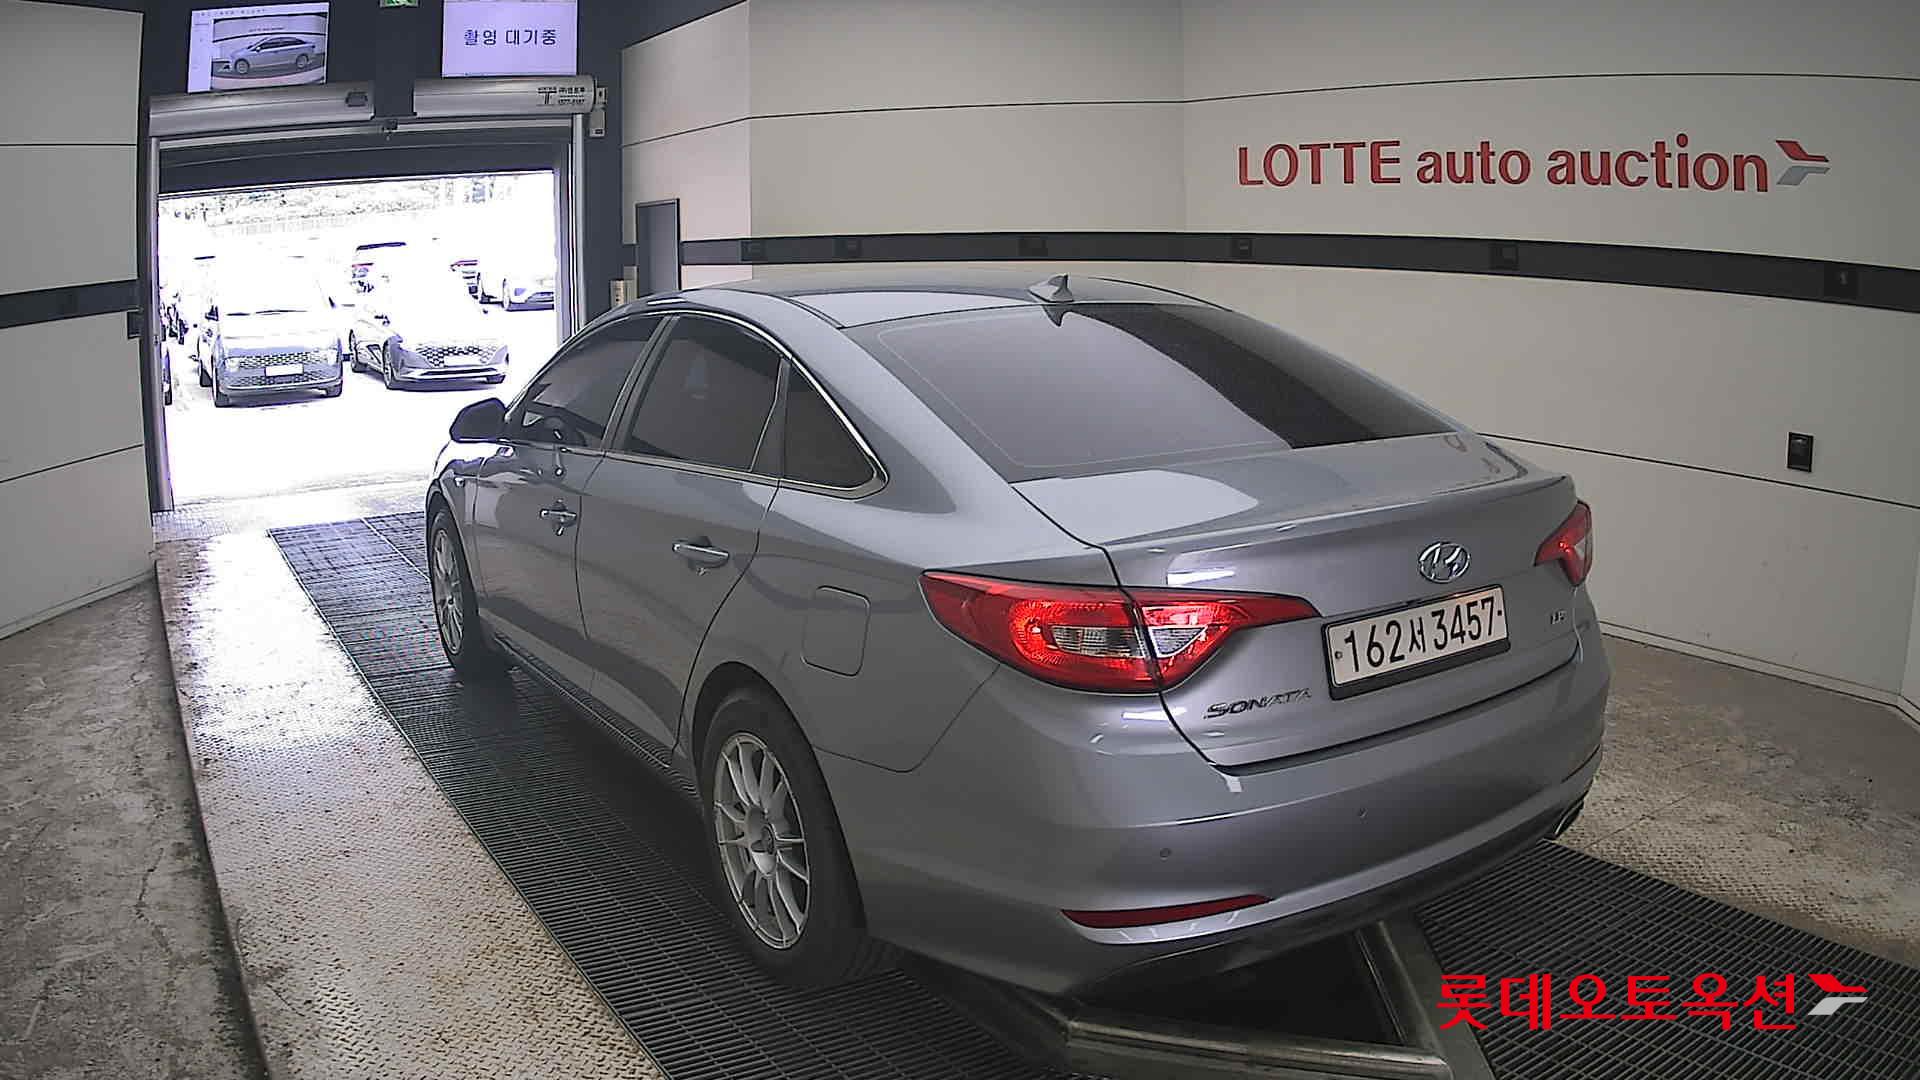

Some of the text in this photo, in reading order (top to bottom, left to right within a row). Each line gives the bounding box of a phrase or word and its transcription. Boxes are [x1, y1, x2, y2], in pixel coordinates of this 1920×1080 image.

[464, 29, 557, 46] 촬영 대기중
[1238, 133, 1770, 193] LOTTE auto auction
[1203, 687, 1312, 720] SONATA
